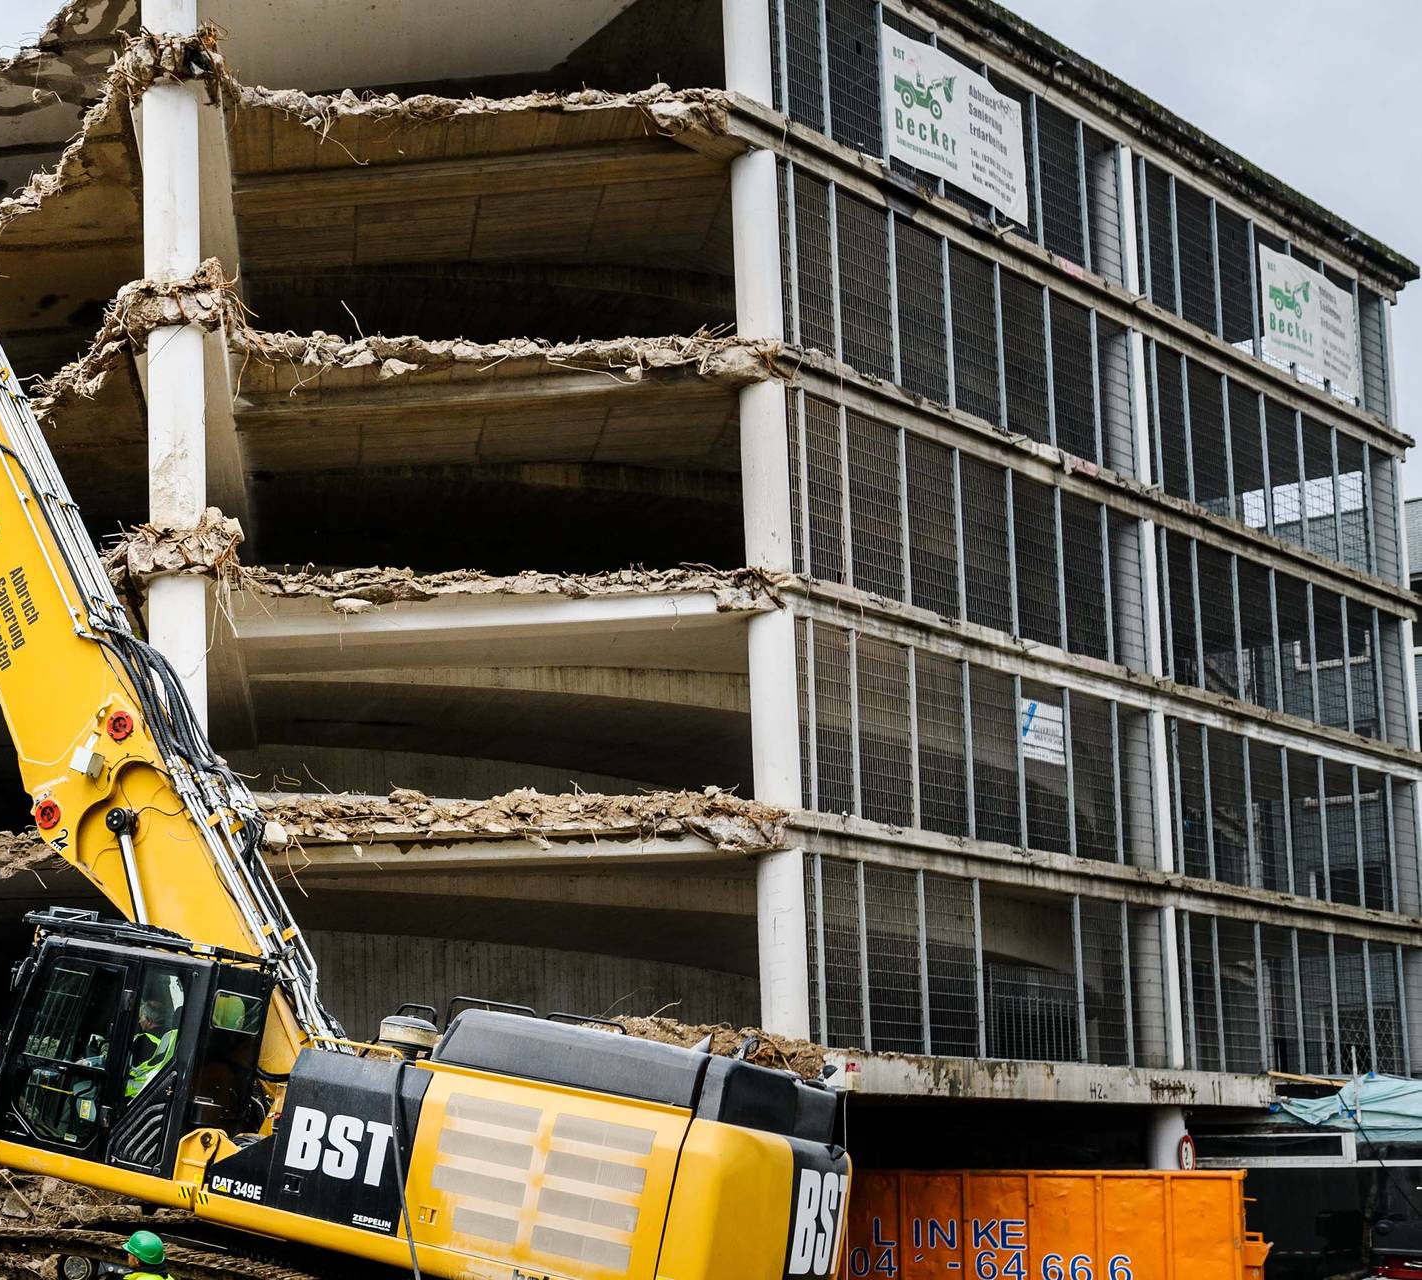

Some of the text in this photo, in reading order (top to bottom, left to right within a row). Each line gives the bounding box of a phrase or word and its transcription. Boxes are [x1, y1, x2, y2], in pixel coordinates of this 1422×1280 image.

[894, 106, 957, 156] Becker
[1269, 311, 1313, 347] Becker
[9, 566, 40, 626] Abbruch
[284, 1105, 394, 1187] BST
[212, 1175, 263, 1201] CAT 349E
[352, 1213, 392, 1228] ZEPPELIN
[788, 1168, 849, 1276] BST
